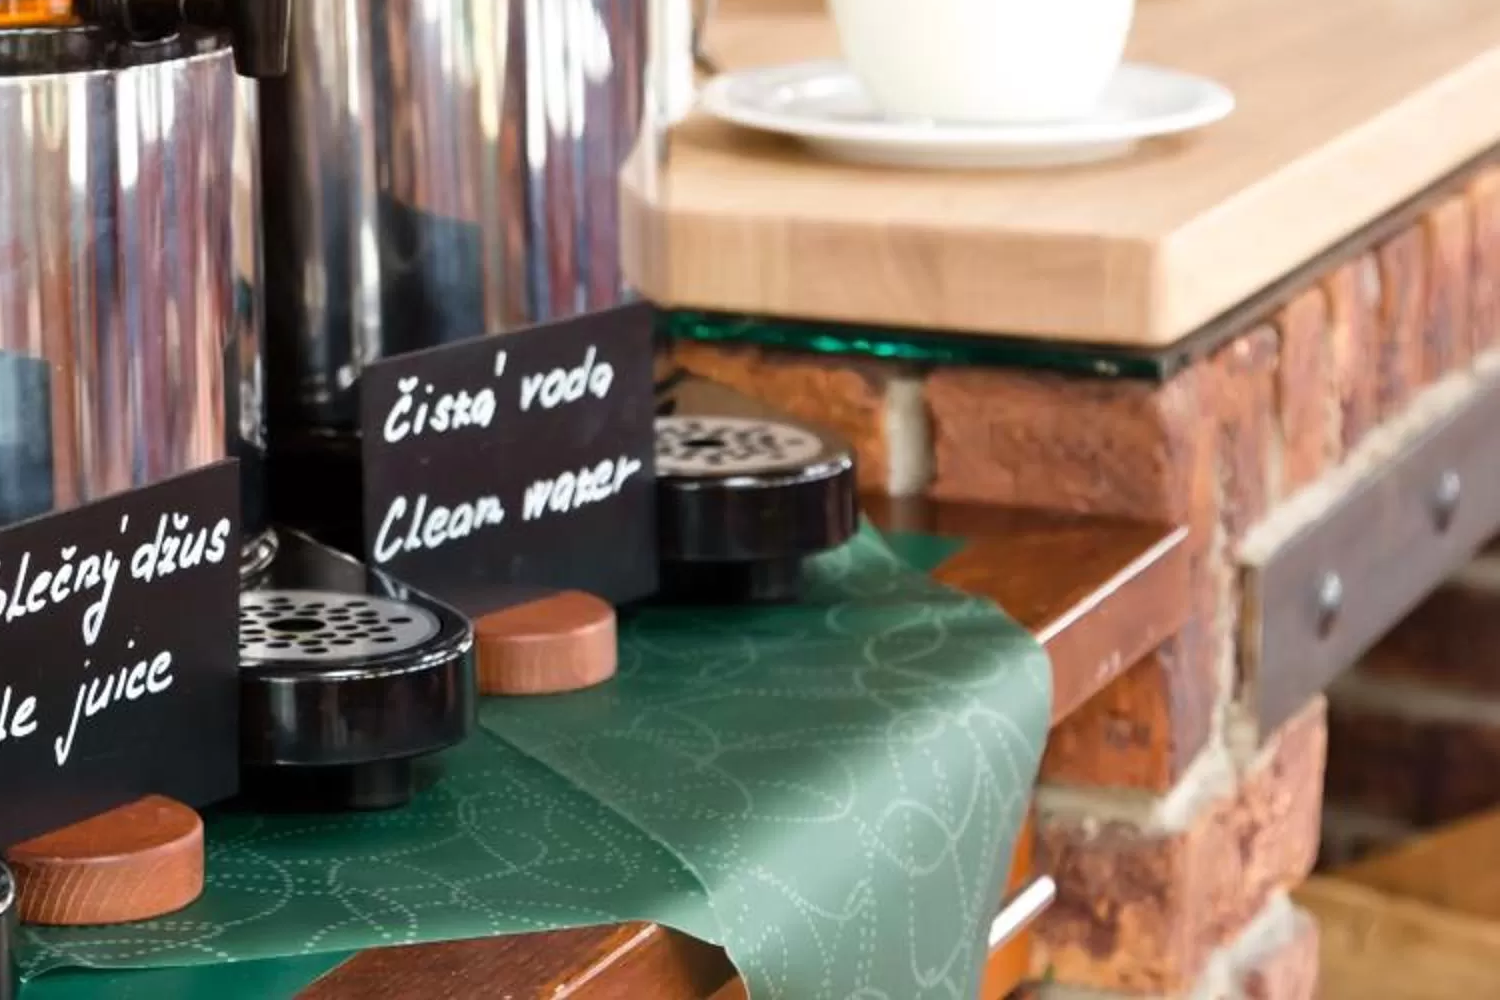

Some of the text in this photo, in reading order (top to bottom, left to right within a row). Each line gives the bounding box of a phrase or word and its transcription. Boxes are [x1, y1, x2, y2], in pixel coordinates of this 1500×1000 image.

[383, 345, 615, 443] Čistá voda
[130, 512, 231, 583] džus
[373, 455, 642, 563] Clean water
[54, 639, 173, 766] juice
